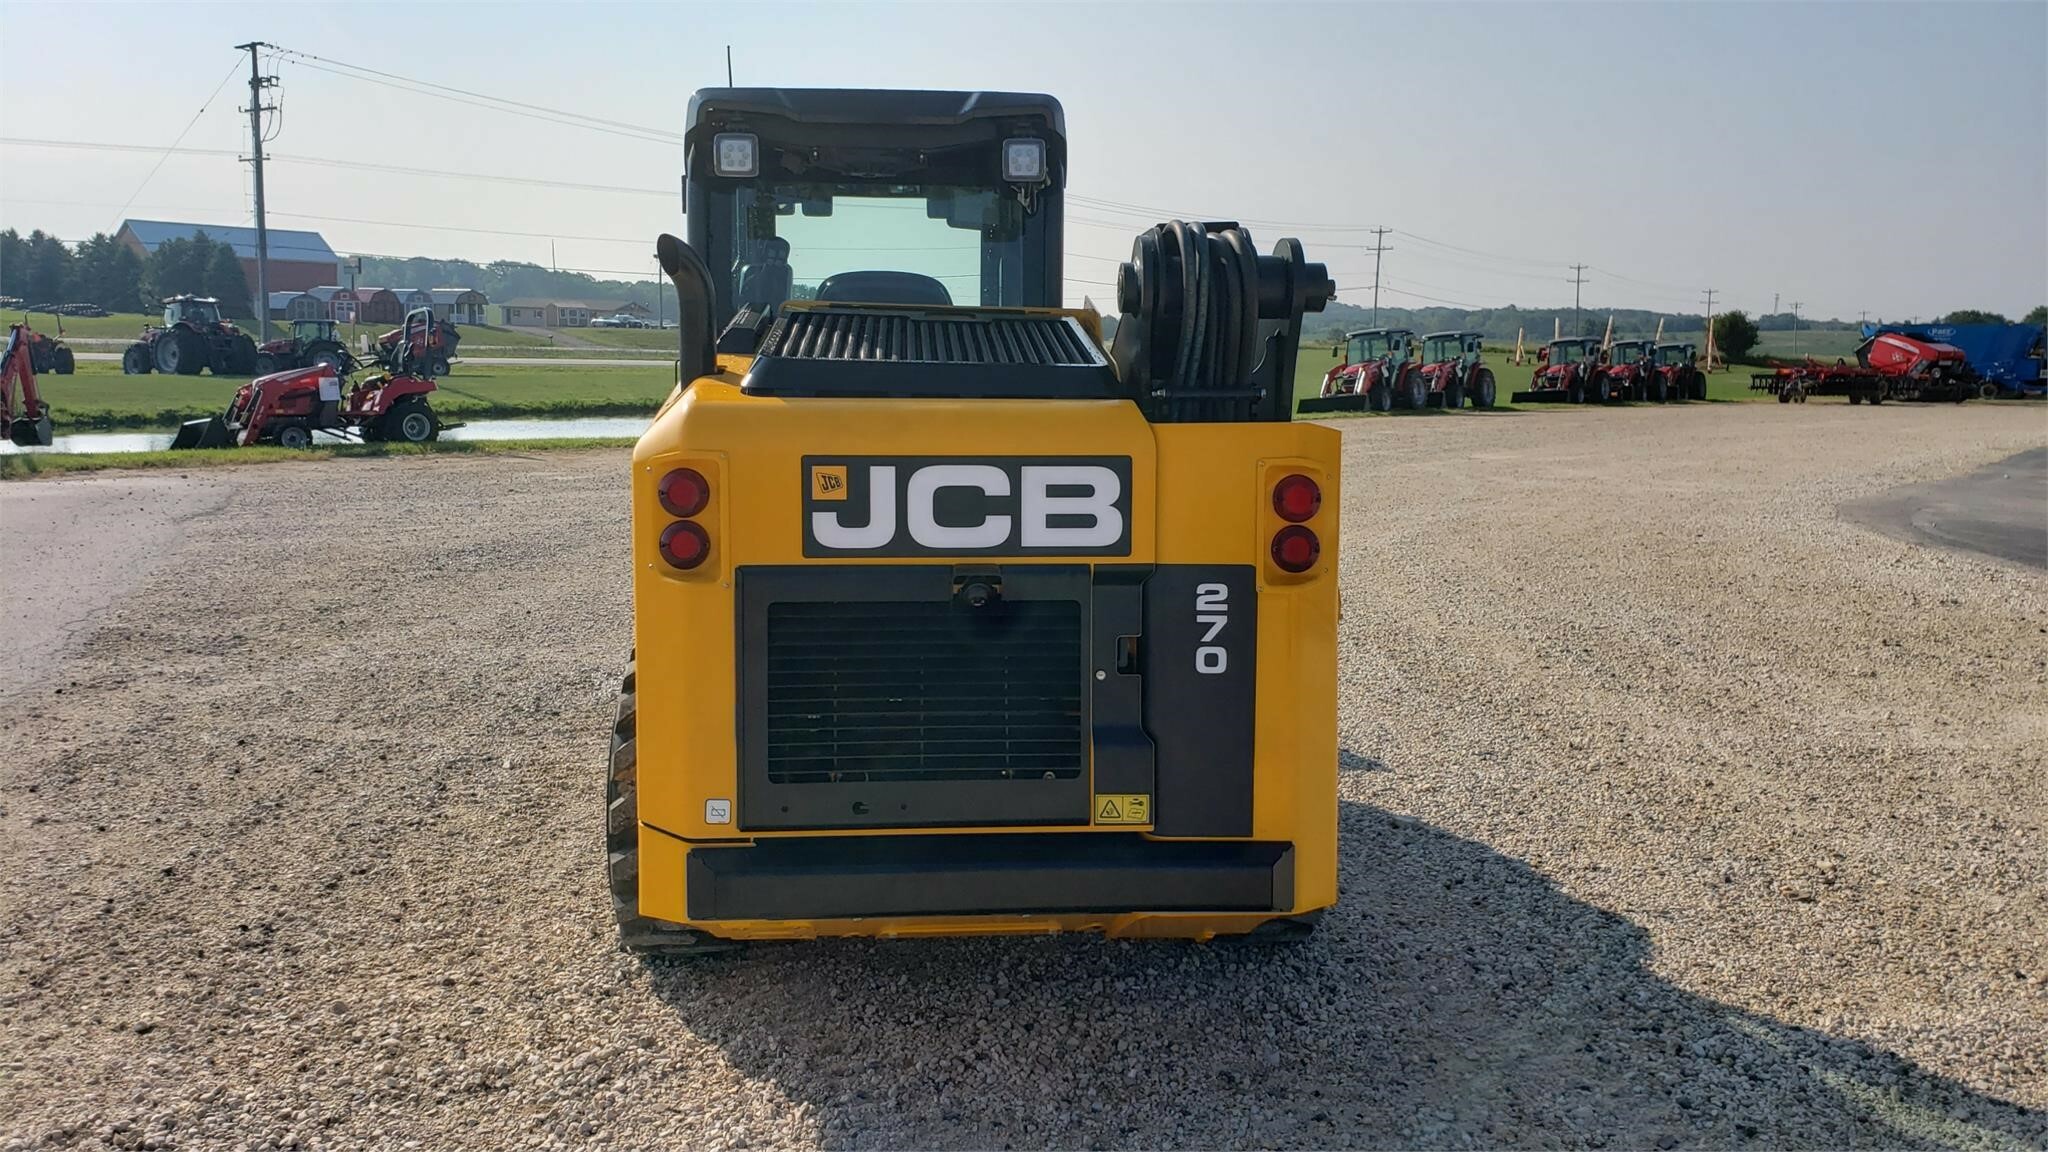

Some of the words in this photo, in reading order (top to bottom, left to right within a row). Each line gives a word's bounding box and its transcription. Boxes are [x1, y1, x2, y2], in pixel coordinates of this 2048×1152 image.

[812, 465, 1123, 548] JCB
[821, 475, 841, 490] JCB
[1196, 583, 1228, 673] 270
